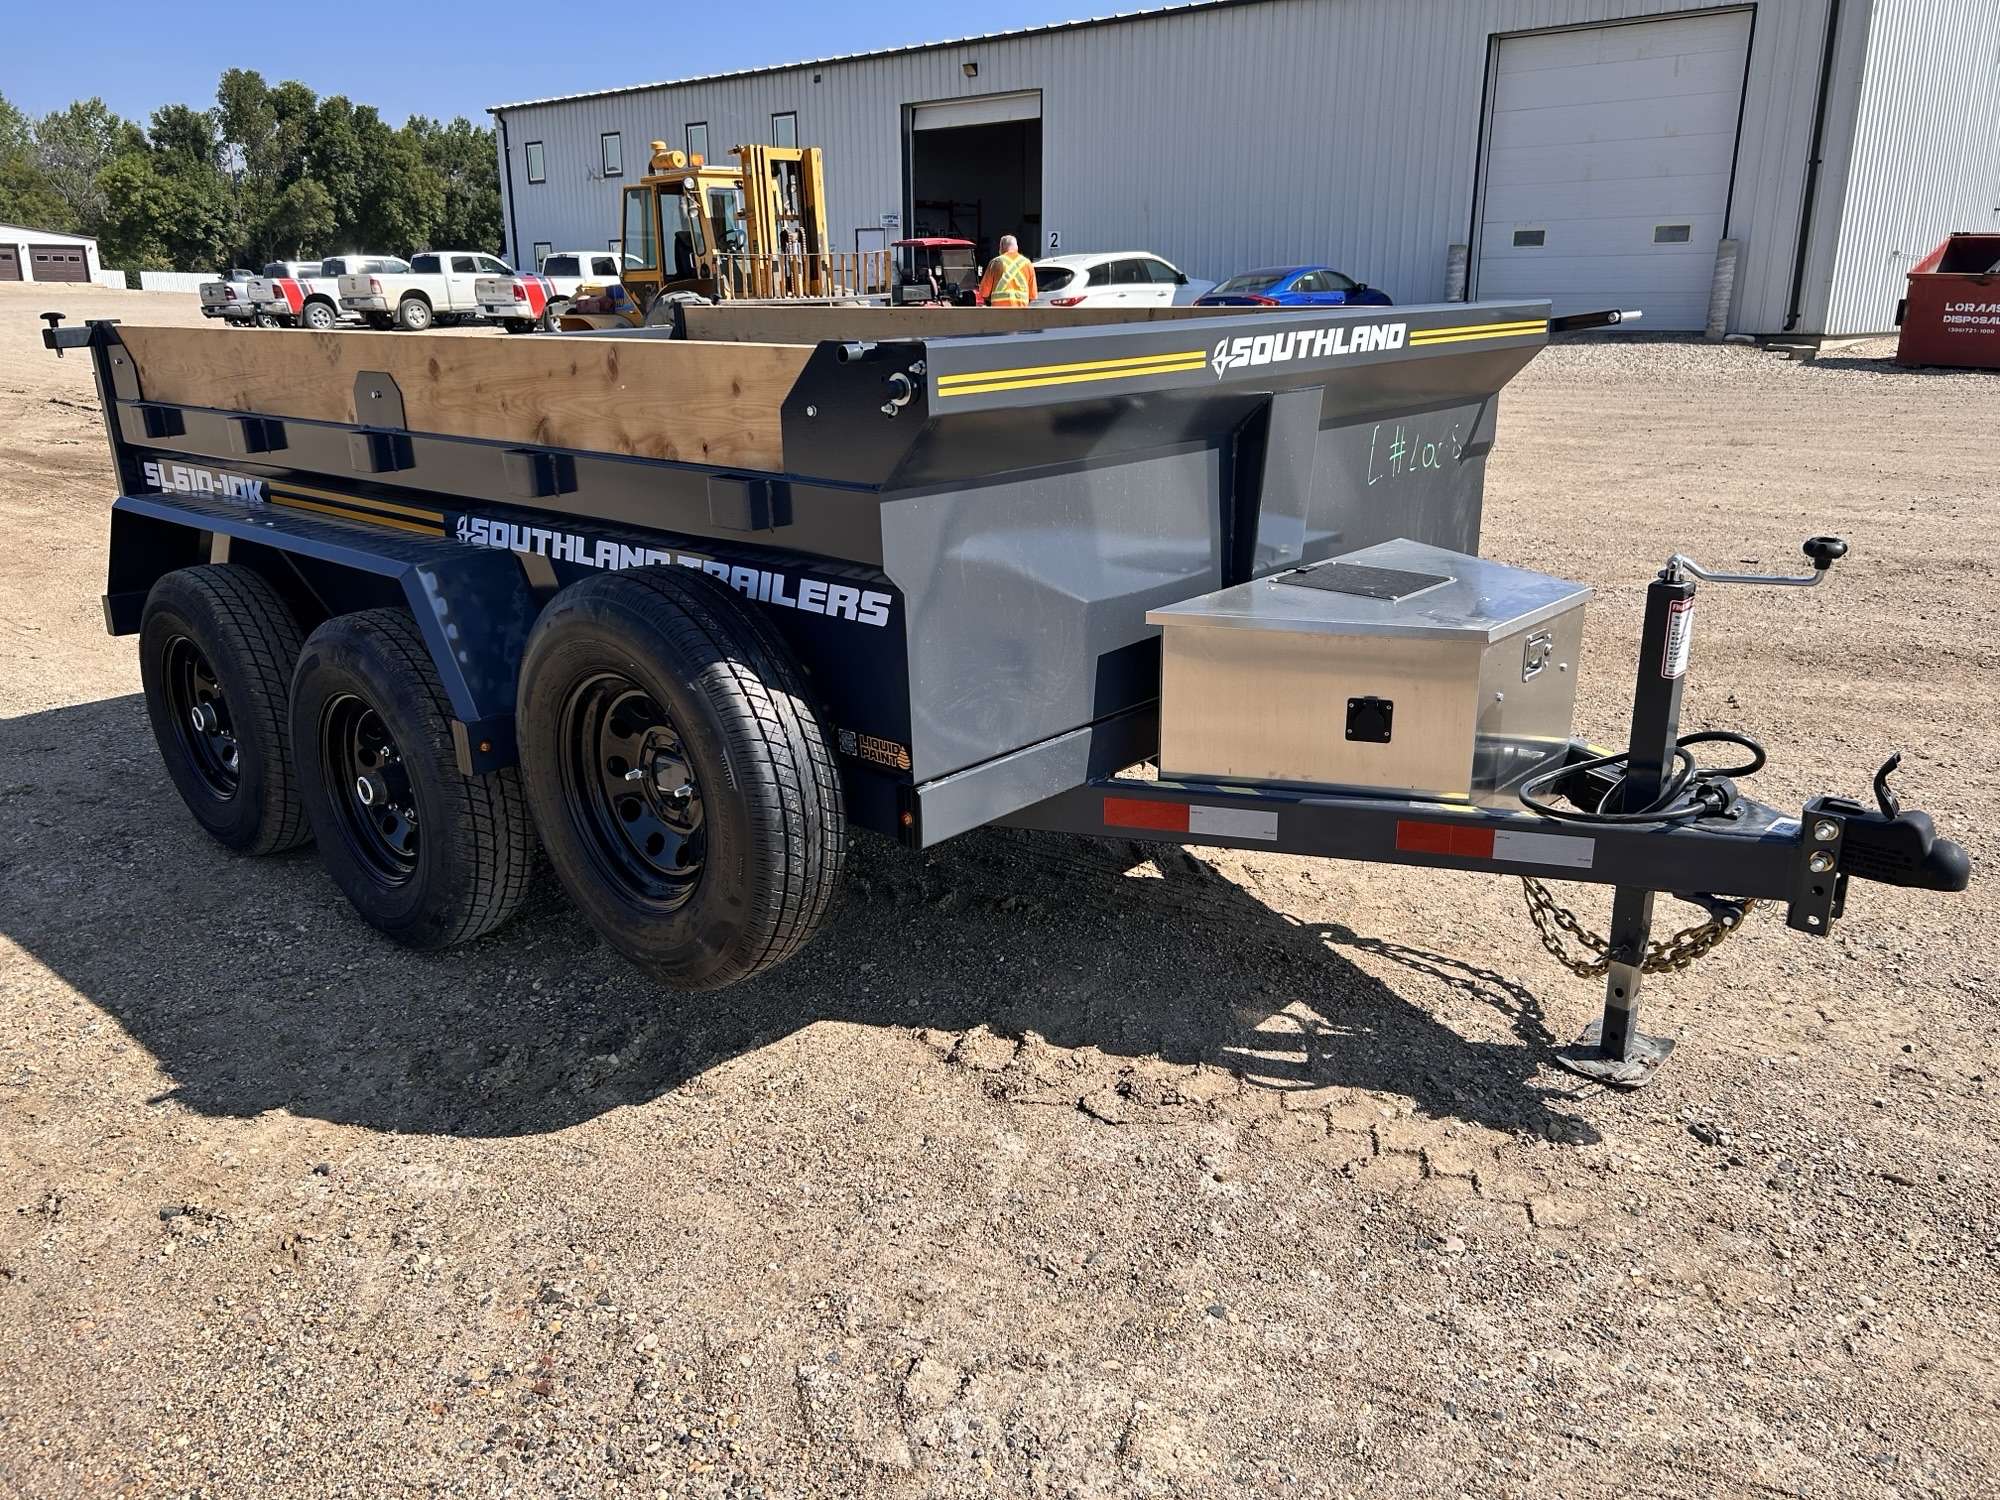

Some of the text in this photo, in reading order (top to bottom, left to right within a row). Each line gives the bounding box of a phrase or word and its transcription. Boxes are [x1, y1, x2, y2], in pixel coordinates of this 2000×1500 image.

[1050, 232, 1058, 248] 2
[1943, 315, 2000, 325] DISPOSAL
[1228, 323, 1407, 368] SOUTHLAND
[143, 461, 264, 504] SL610-10K
[471, 518, 670, 571] SOUTHLAND
[859, 734, 900, 755] LIQUID
[860, 746, 898, 768] PAINT
